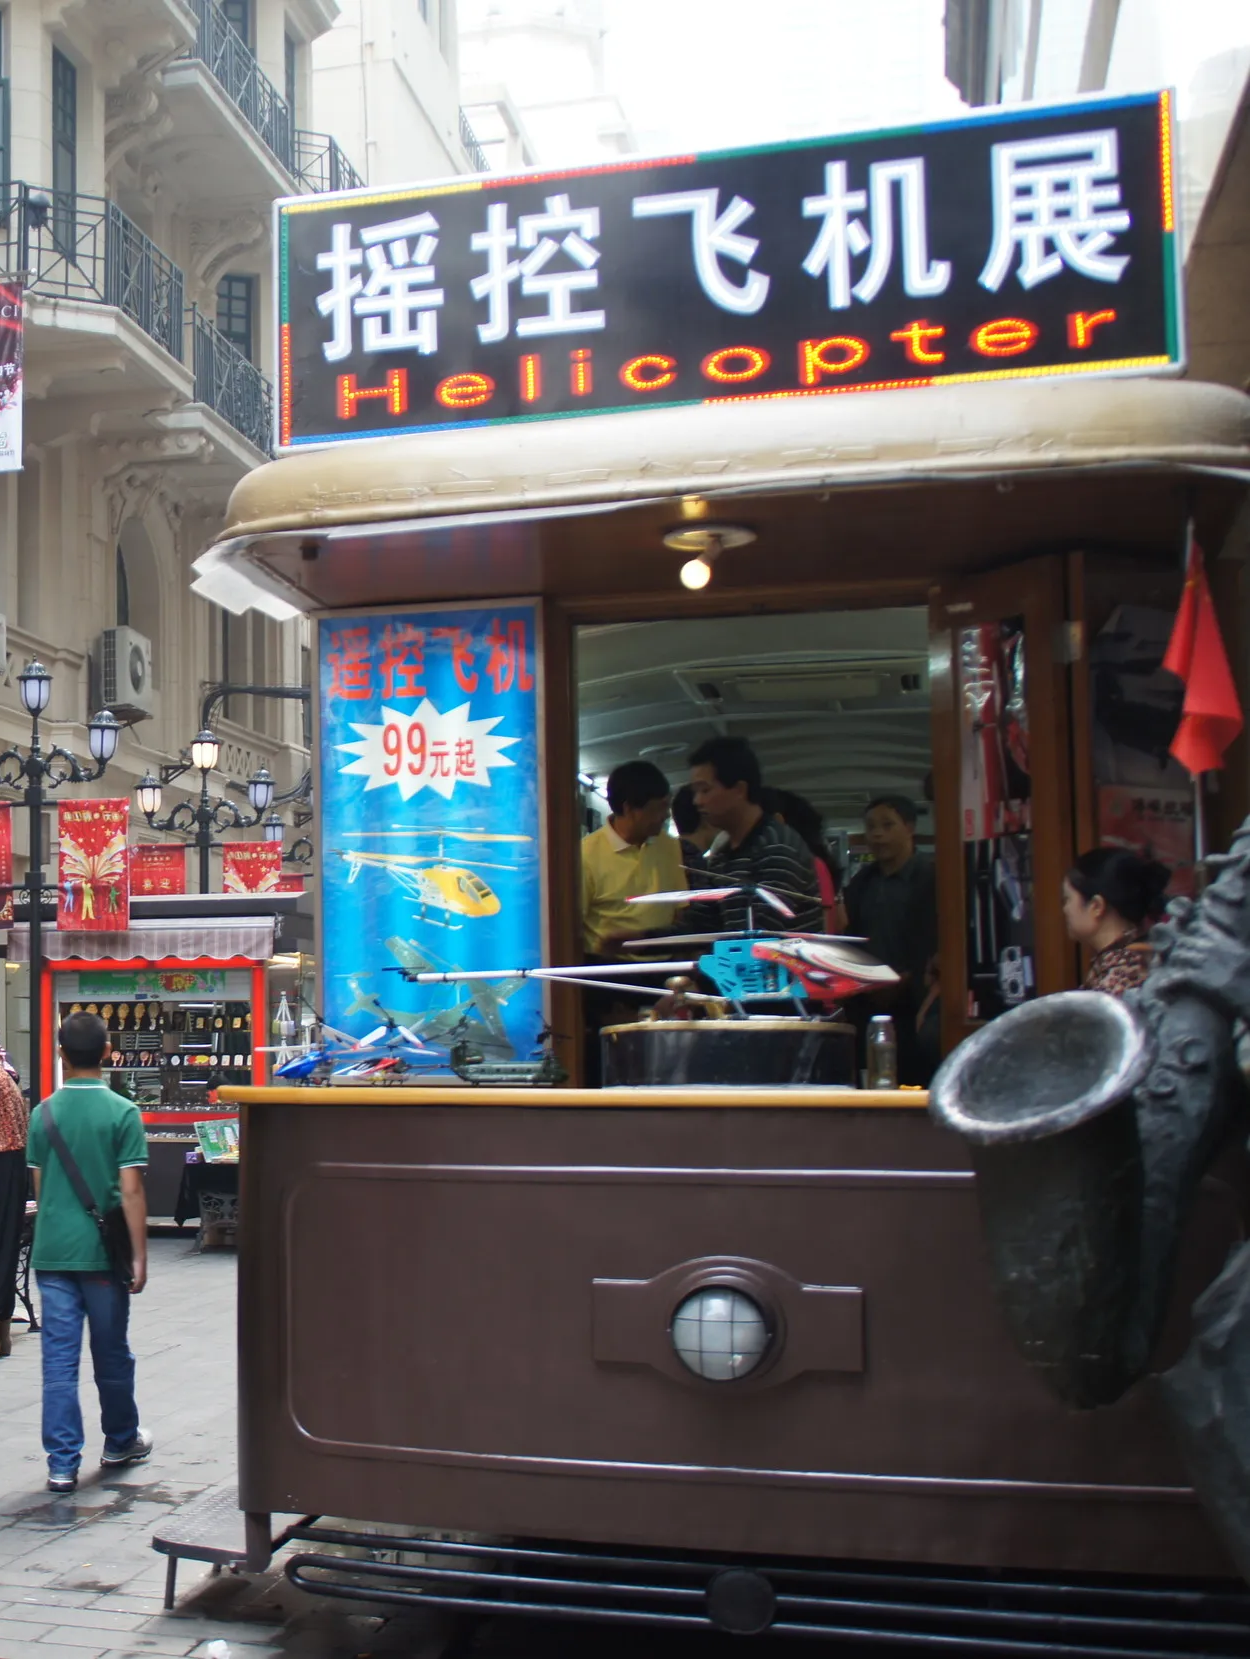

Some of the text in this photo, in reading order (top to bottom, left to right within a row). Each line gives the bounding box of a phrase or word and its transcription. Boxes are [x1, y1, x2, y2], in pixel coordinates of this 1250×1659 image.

[315, 126, 1132, 363] 摇控飞机展
[334, 308, 1118, 420] Helicopter
[326, 617, 534, 700] 遥控飞机
[382, 721, 476, 778] 99元起
